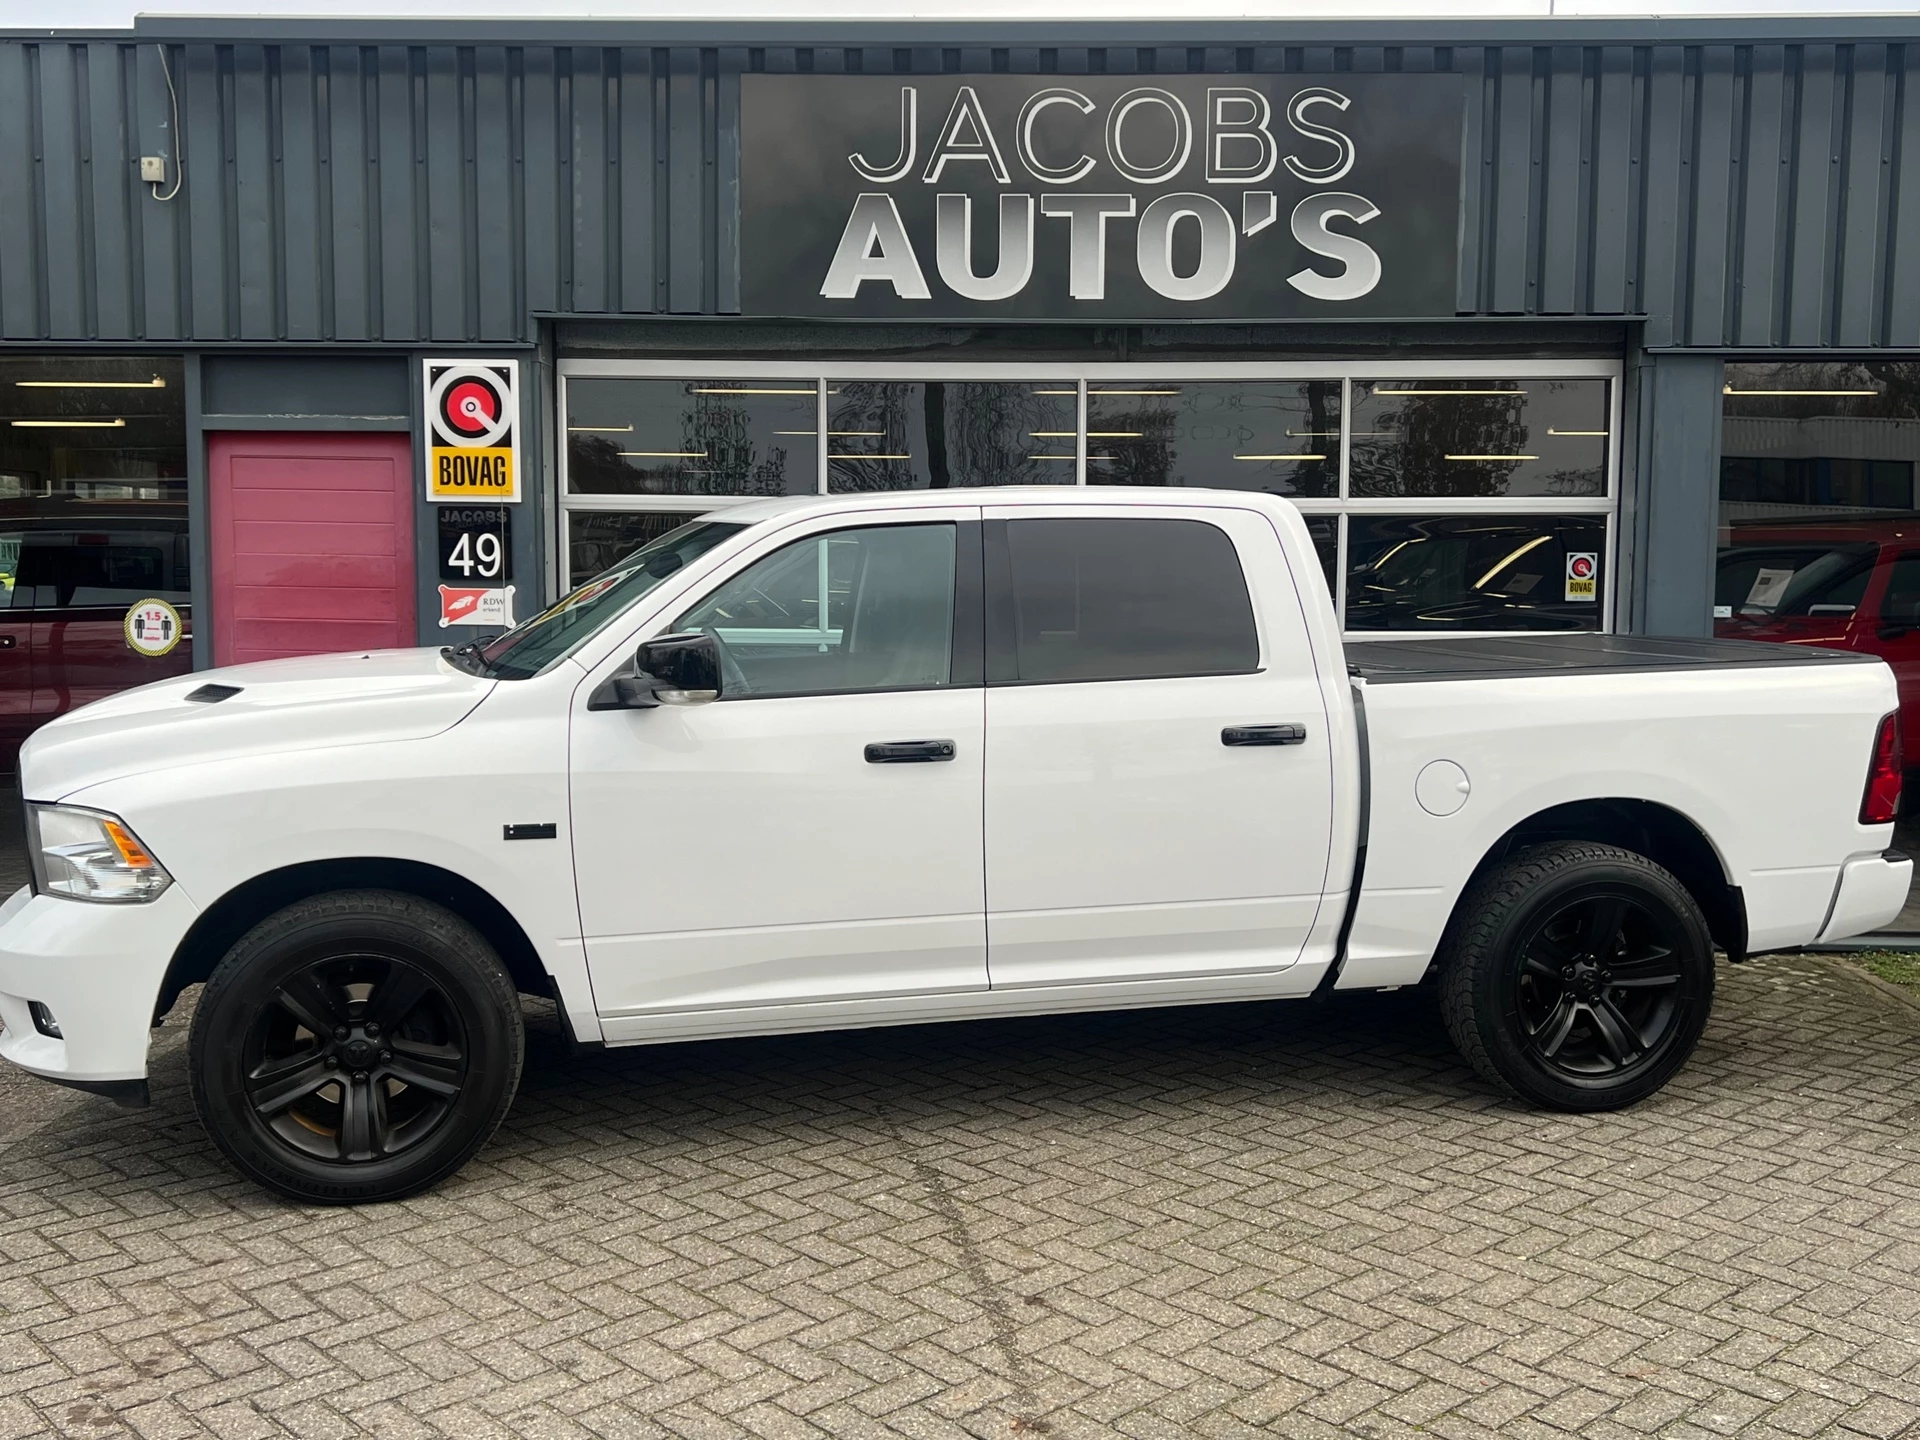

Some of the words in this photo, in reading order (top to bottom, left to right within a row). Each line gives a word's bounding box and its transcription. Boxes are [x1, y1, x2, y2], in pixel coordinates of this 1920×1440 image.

[848, 86, 1357, 185] JACOBS
[819, 190, 1383, 302] AUTO'S
[440, 456, 505, 486] BOVAG
[441, 510, 507, 523] JACOBS
[449, 533, 501, 576] 49
[1570, 582, 1591, 592] BOVAG
[482, 597, 504, 606] RDW
[145, 611, 161, 621] 1.5
